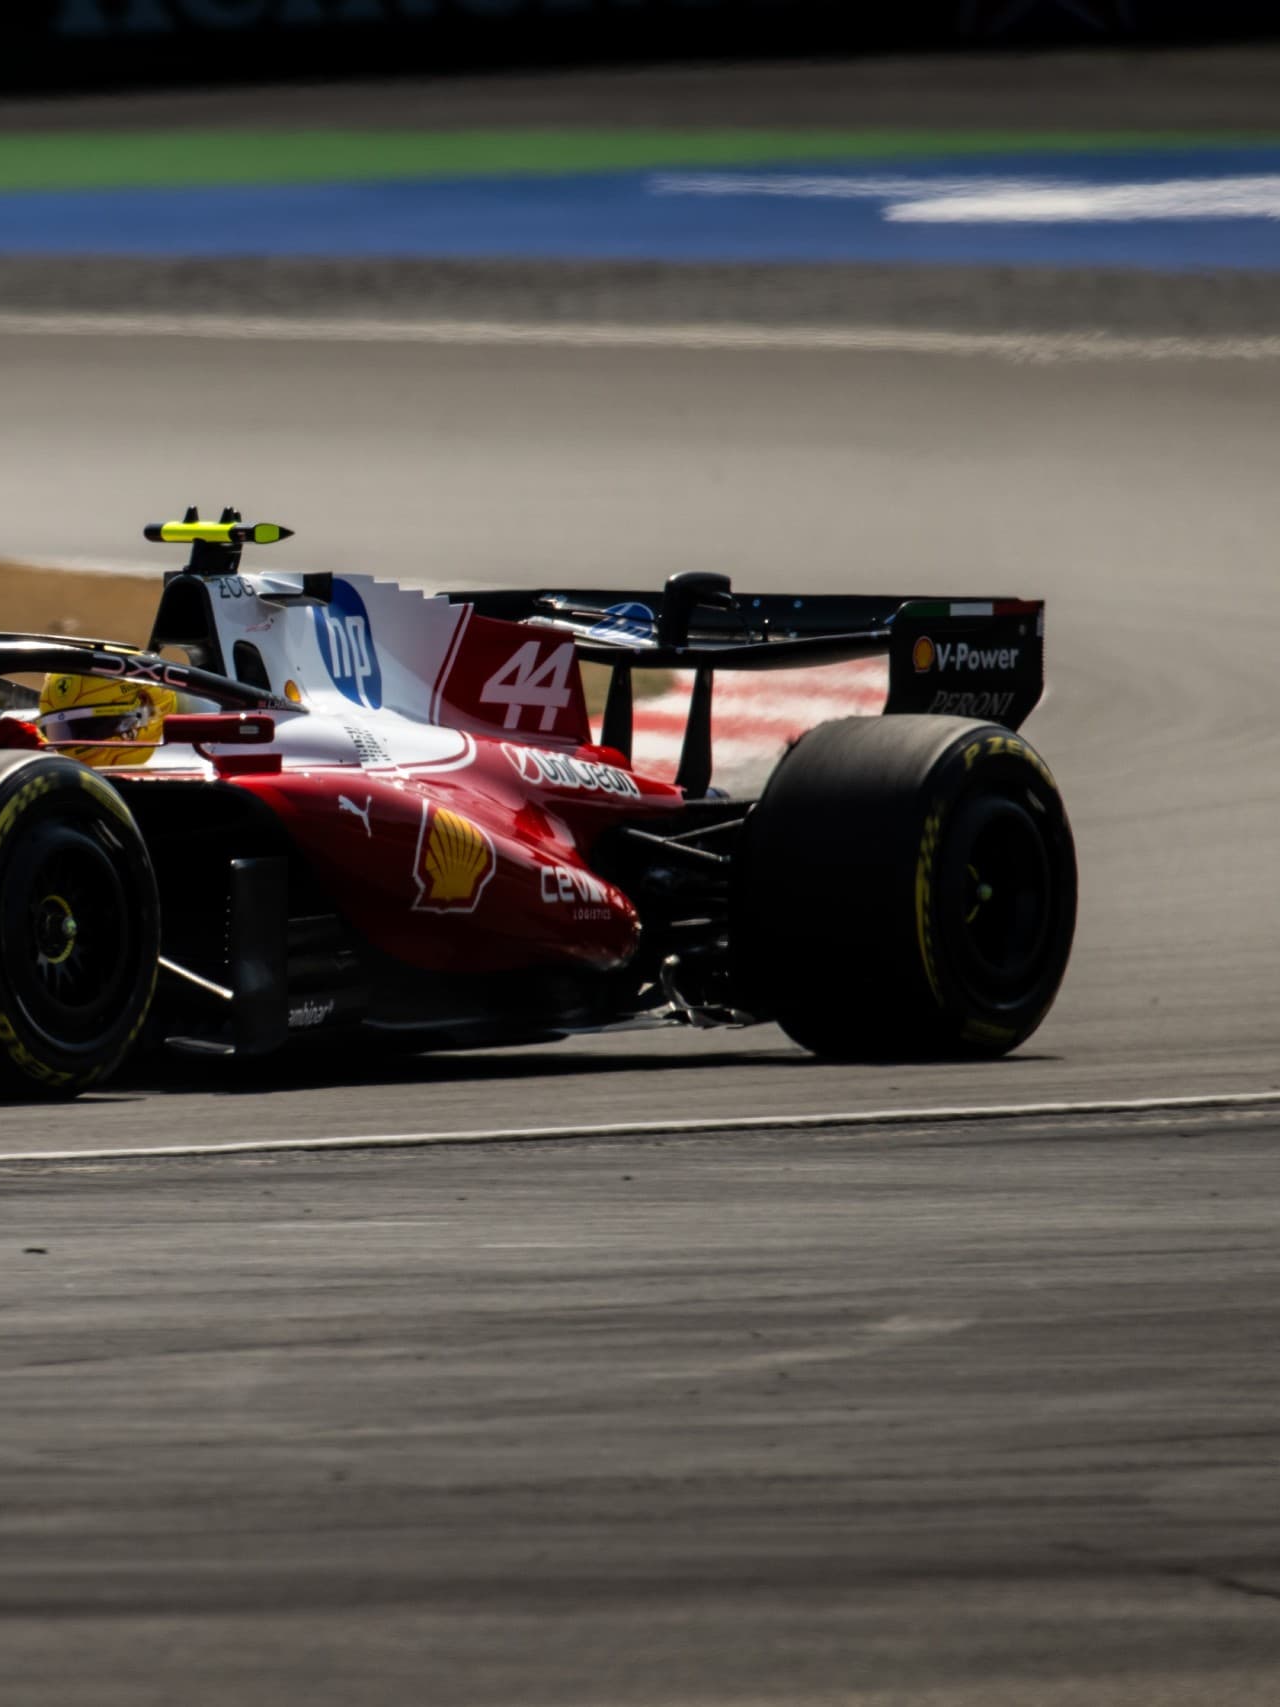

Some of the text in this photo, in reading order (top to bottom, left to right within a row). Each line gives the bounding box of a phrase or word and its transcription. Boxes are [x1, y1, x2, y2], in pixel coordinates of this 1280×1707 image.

[91, 653, 189, 687] DXC
[324, 602, 372, 706] hp
[935, 641, 1020, 672] V-Power
[479, 640, 575, 730] 44
[928, 688, 1016, 717] PERONI
